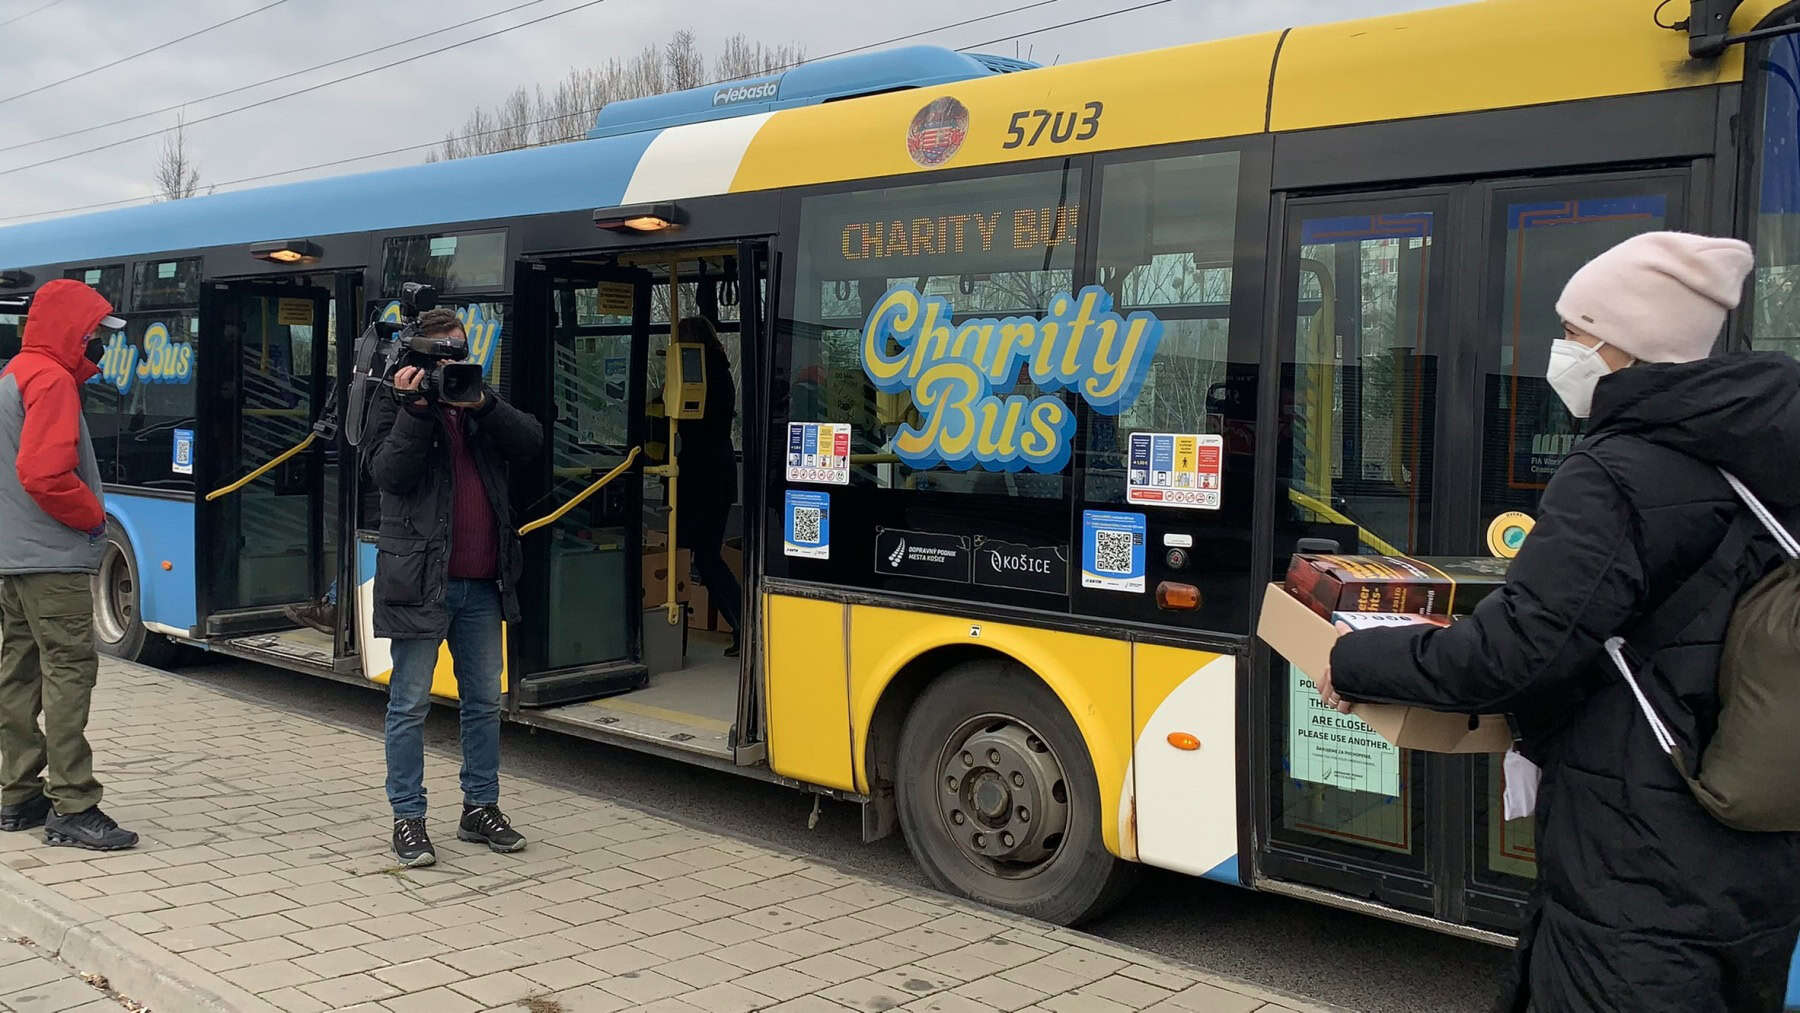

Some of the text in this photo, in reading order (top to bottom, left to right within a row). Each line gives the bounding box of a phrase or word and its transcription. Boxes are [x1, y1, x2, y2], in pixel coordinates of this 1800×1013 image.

[713, 83, 777, 105] Webasto
[842, 210, 1001, 260] CHARITY
[138, 324, 192, 380] Bus
[863, 287, 1152, 402] Charity
[895, 361, 1067, 461] Bus
[909, 553, 926, 561] MESTA
[1004, 554, 1051, 574] KOŠICE
[1312, 715, 1332, 727] ARE
[1298, 728, 1391, 751] PLEASE USE ANOTHER.
